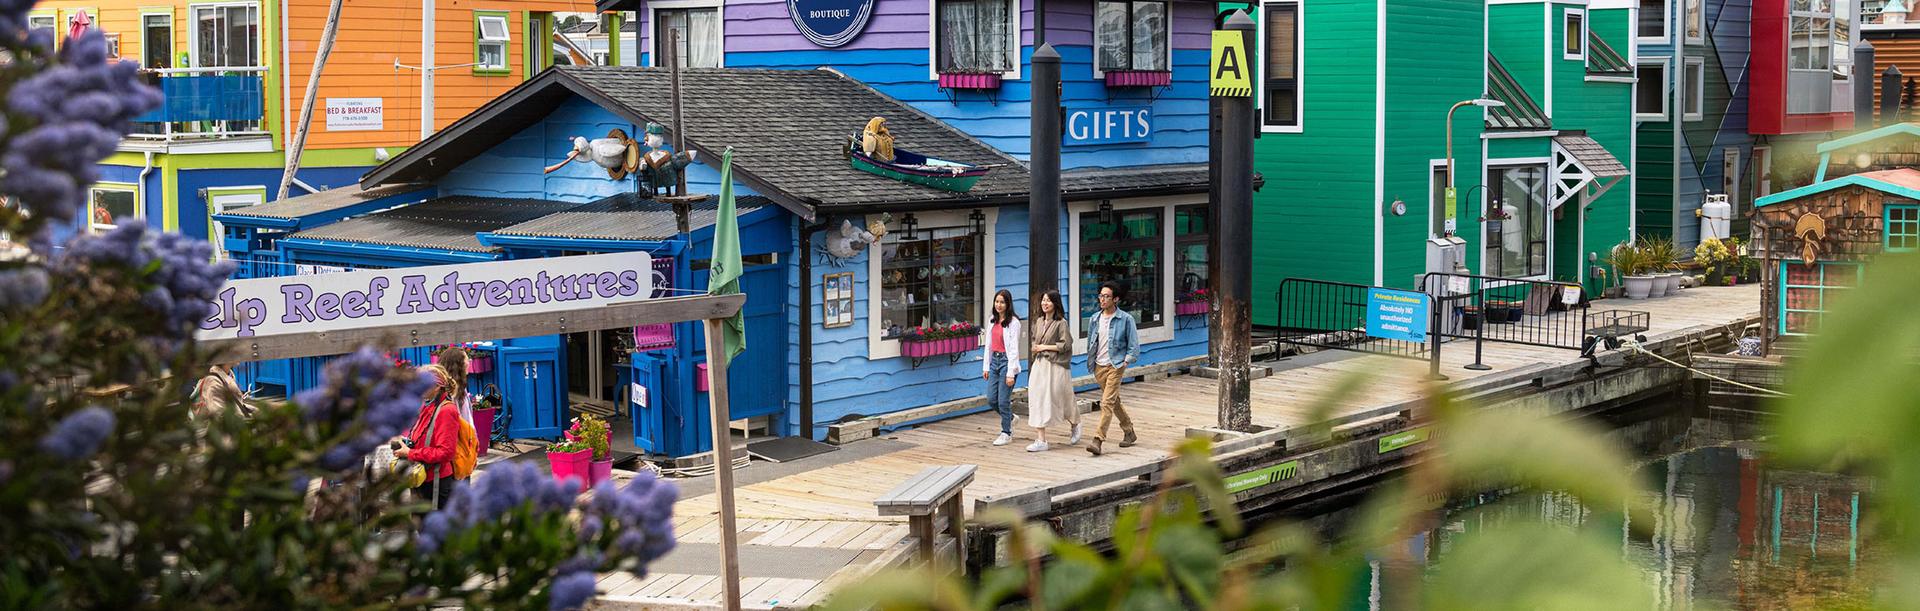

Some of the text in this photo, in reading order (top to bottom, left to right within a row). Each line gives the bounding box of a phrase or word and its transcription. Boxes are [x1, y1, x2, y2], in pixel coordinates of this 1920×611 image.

[810, 9, 850, 19] BOUTIQUE
[1216, 46, 1241, 79] A
[348, 106, 381, 114] BREAKFAST
[1068, 109, 1150, 140] GIFTS
[1375, 293, 1392, 301] Private
[199, 269, 639, 337] elp Reef Adventures
[1380, 304, 1404, 314] Absolutely
